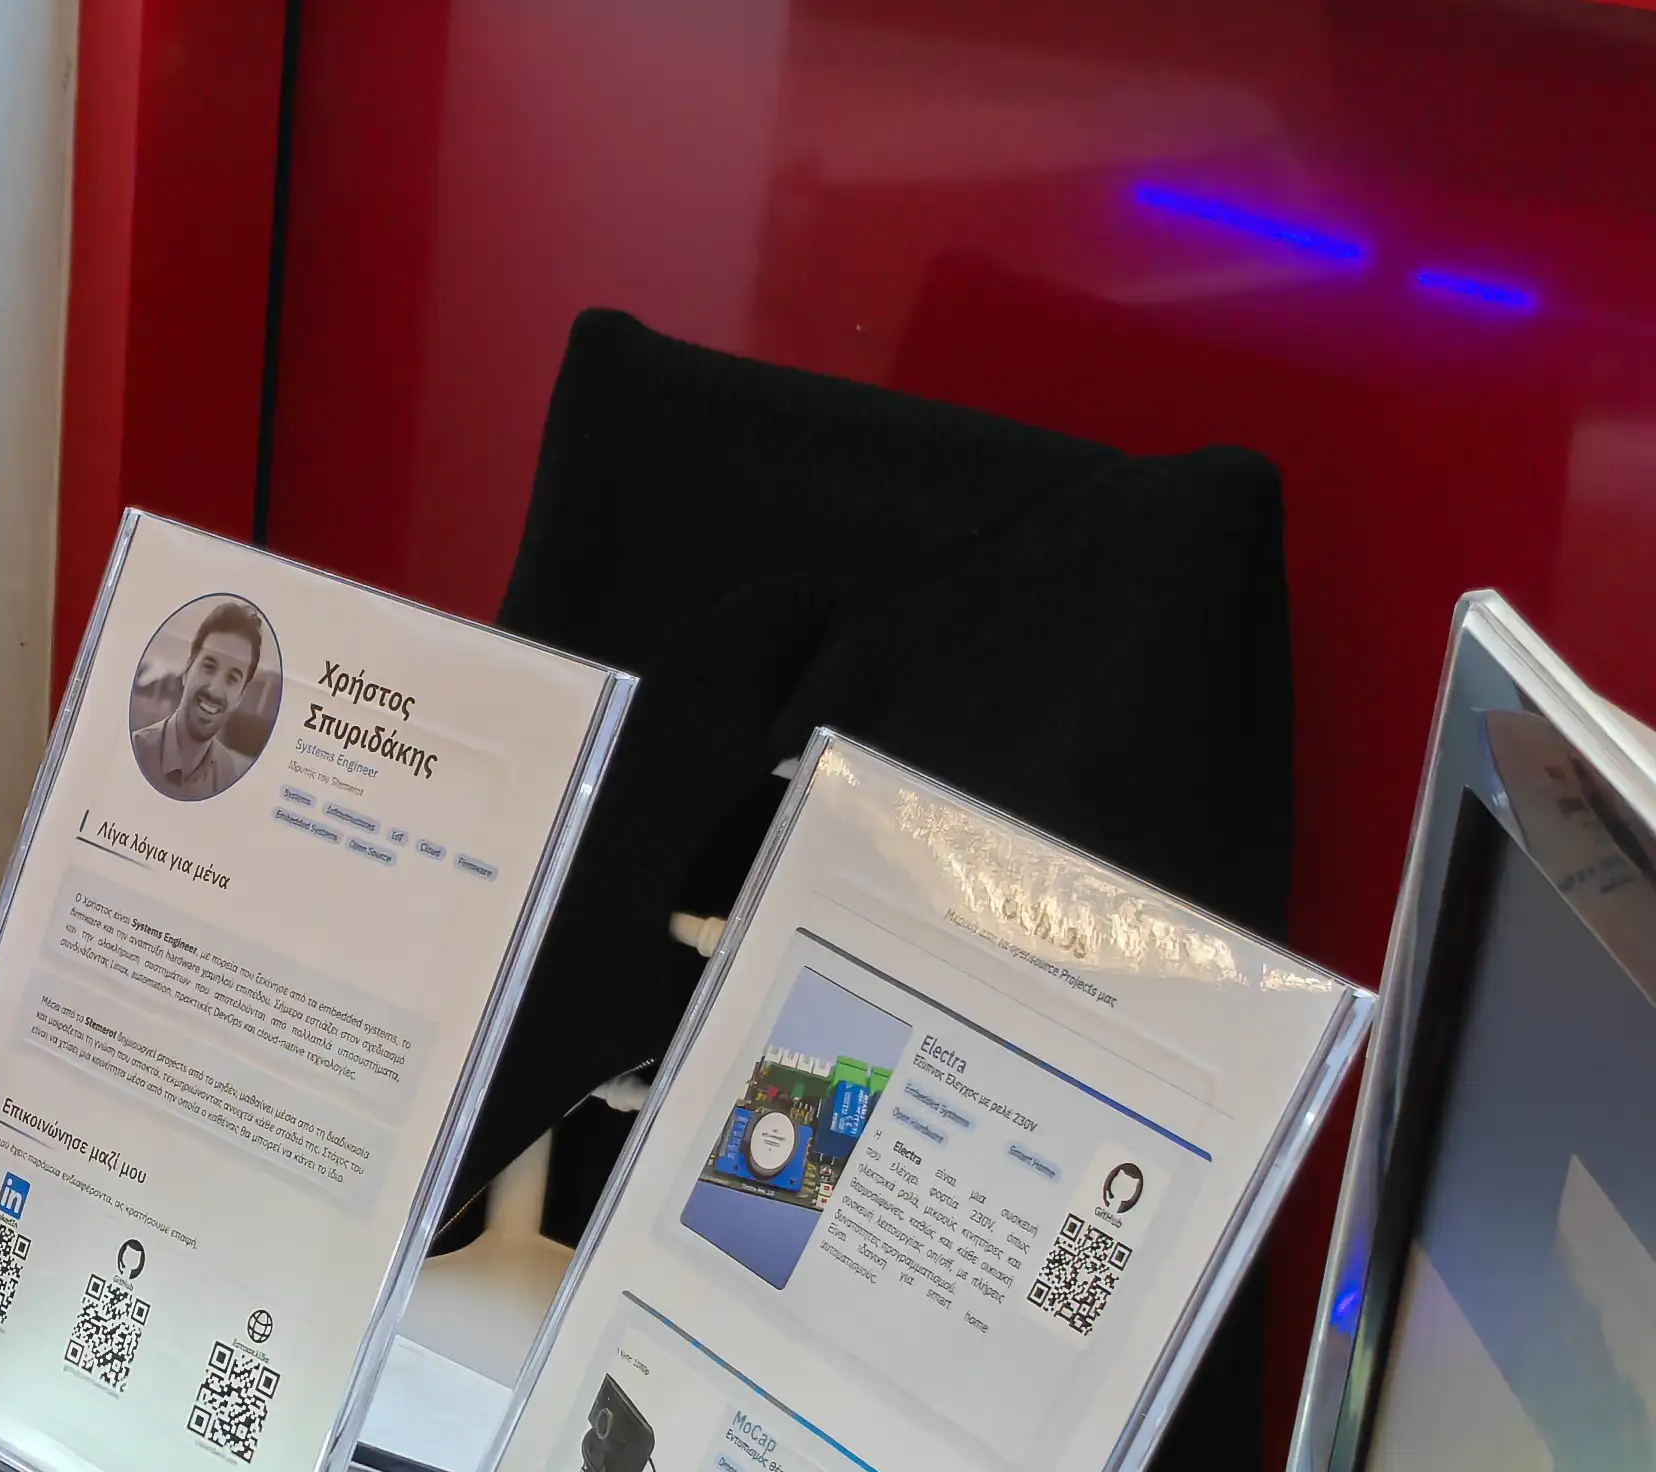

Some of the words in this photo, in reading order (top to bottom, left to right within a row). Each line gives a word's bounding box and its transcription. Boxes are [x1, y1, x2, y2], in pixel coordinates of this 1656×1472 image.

[319, 661, 414, 720] Χρήστος
[296, 739, 334, 762] Systems
[337, 754, 378, 777] Engineer
[305, 704, 436, 777] Σπυριδάκης
[97, 822, 129, 846] Λίγα
[130, 834, 168, 863] λόγια
[169, 854, 193, 873] για
[193, 864, 230, 889] μένα
[166, 950, 200, 973] hardware
[132, 918, 162, 939] Systems
[255, 972, 288, 995] ξεκίνησε
[290, 991, 305, 1002] από
[319, 1004, 363, 1027] embedded
[364, 1023, 398, 1045] systems,
[1059, 969, 1097, 996] Projects
[1096, 992, 1117, 1008] μας
[921, 1035, 966, 1073] Electra
[85, 1017, 117, 1038] Stemerot
[275, 1110, 297, 1124] μέσα
[298, 1120, 314, 1132] από
[3, 1098, 87, 1153] Επικοινώνησε
[89, 1147, 120, 1170] μαζί
[119, 1162, 146, 1183] μου
[1012, 1113, 1037, 1131] 230V
[240, 1126, 251, 1138] θα
[251, 1134, 281, 1153] μπορεί
[282, 1147, 292, 1158] να
[893, 1141, 921, 1165] Electra
[1095, 1207, 1122, 1228] GitHub
[730, 1411, 776, 1454] MoCap
